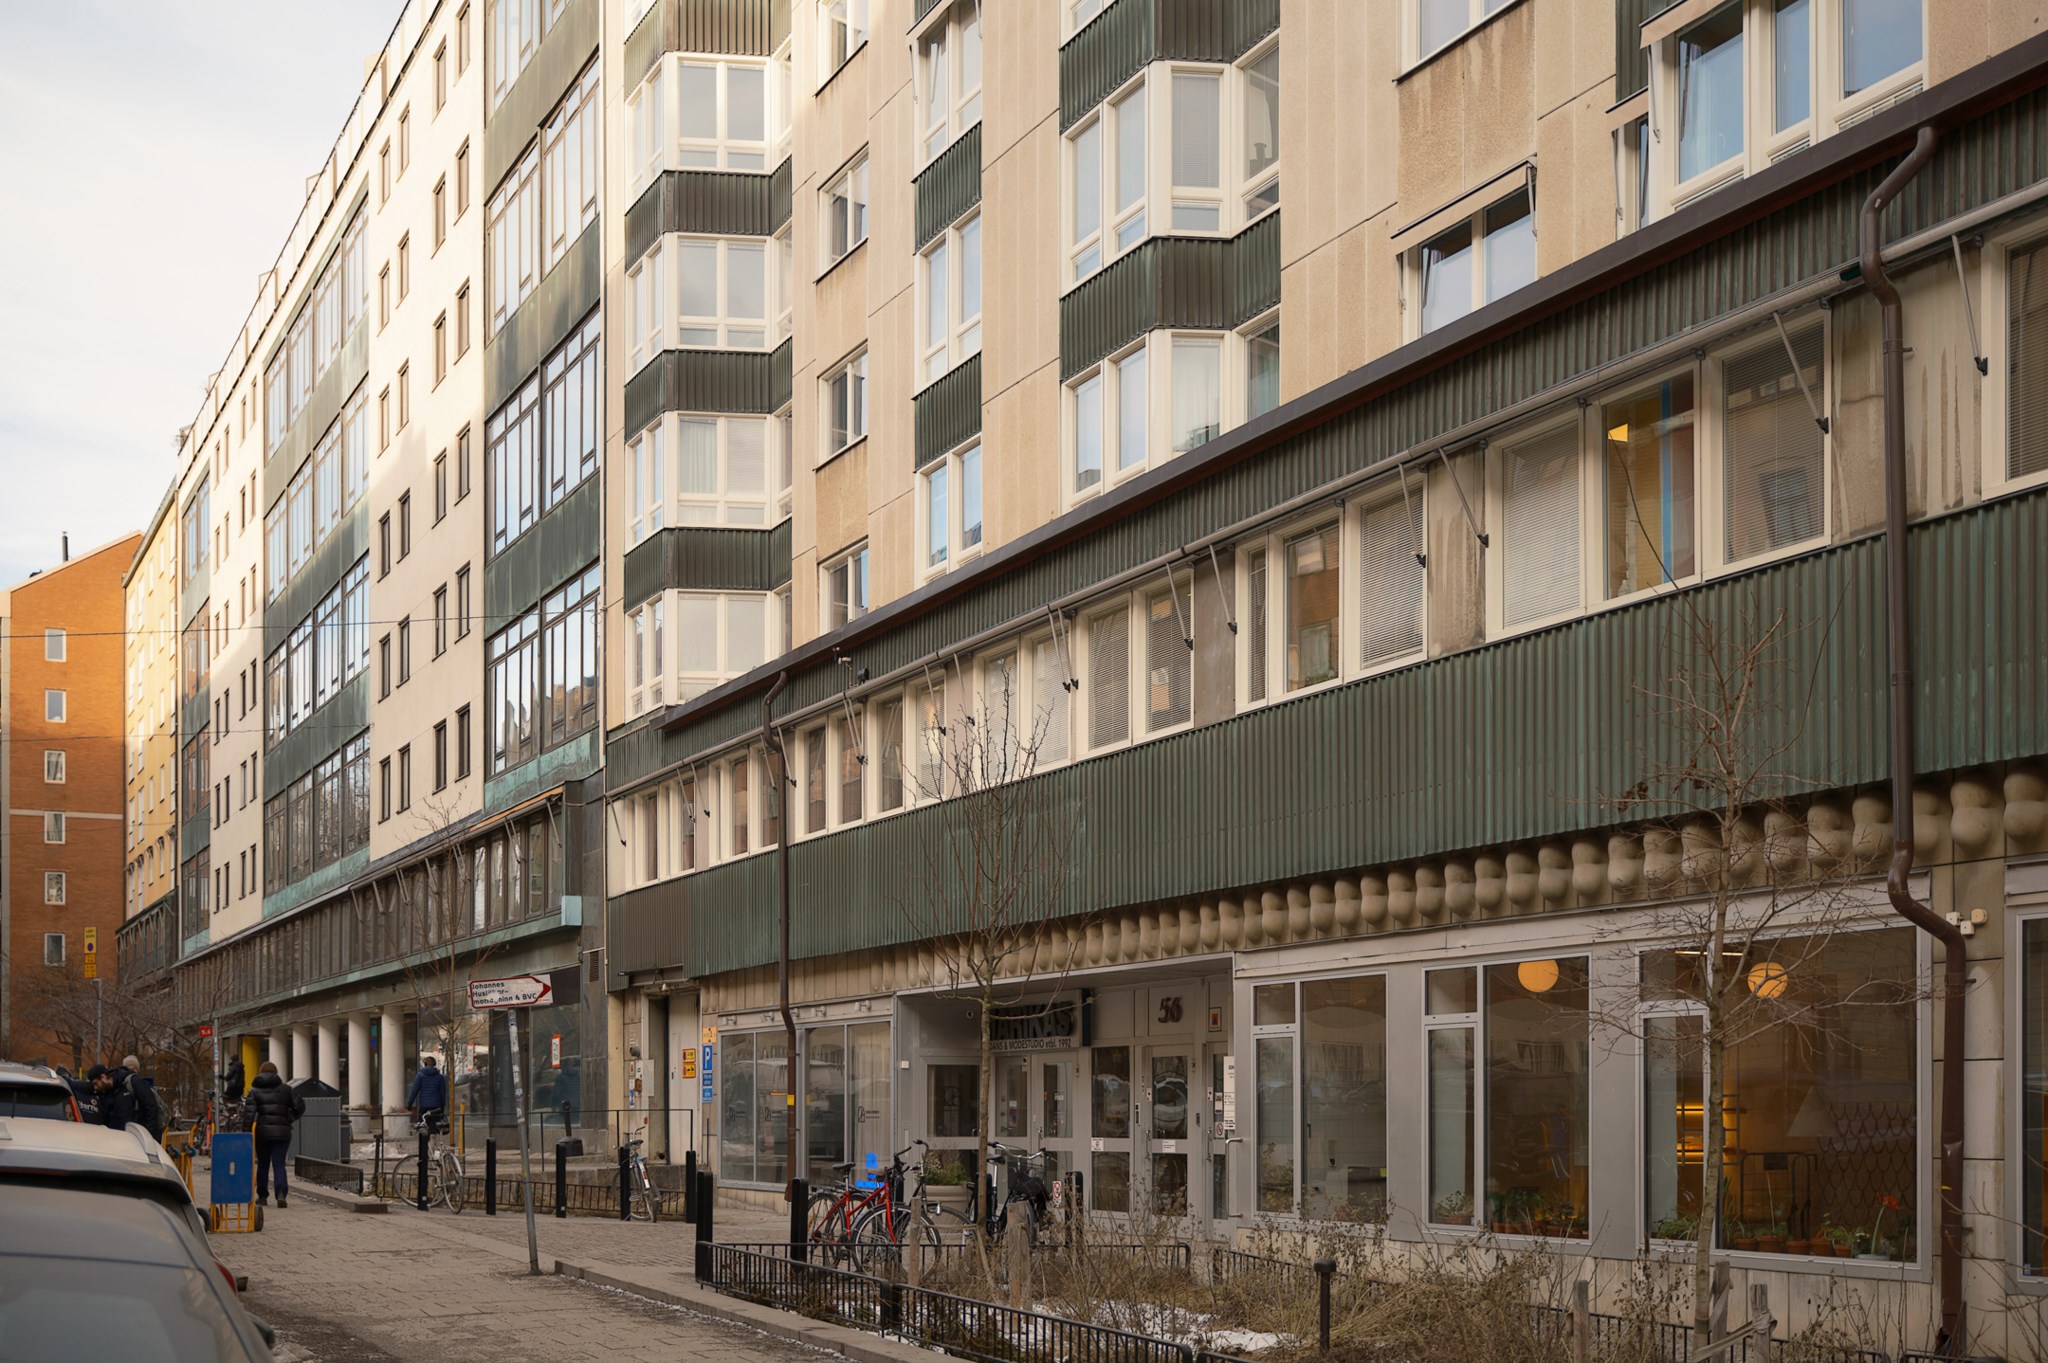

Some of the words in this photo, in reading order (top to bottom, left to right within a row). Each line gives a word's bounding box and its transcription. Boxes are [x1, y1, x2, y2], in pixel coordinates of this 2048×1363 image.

[472, 982, 505, 990] Johannes
[1158, 997, 1183, 1023] 56
[1004, 1040, 1008, 1050] &
[1009, 1039, 1045, 1050] MODESTUDIO
[1058, 1038, 1071, 1048] 1992
[704, 1047, 711, 1070] P
